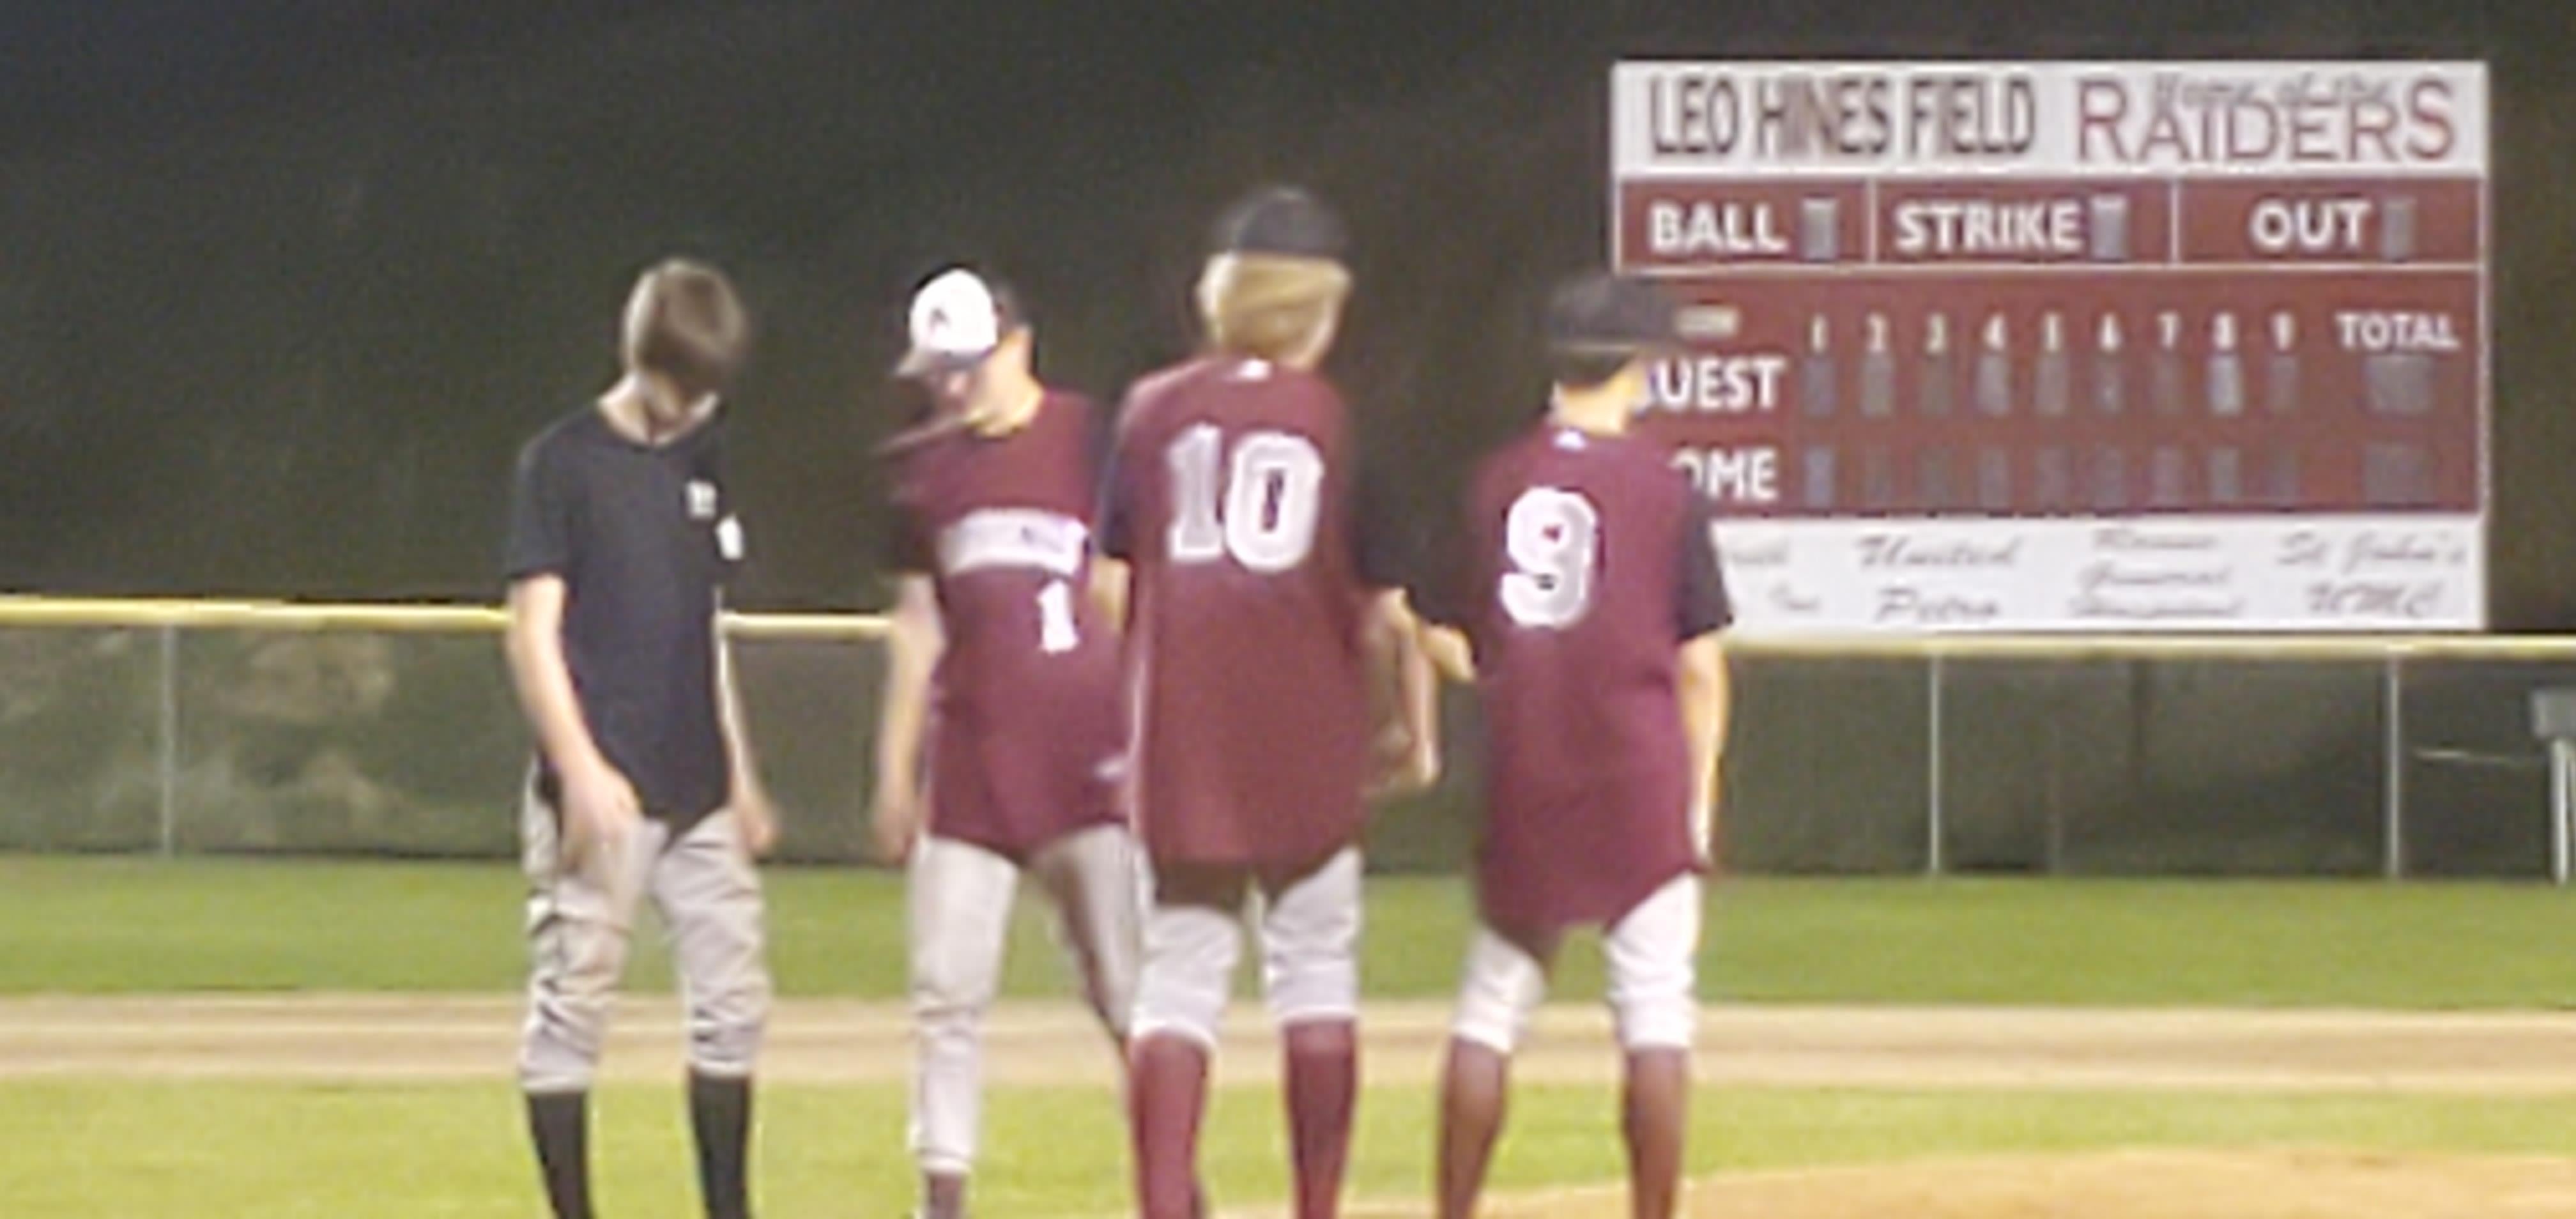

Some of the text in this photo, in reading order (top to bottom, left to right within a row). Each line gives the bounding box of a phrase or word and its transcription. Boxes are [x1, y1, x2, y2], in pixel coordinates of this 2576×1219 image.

[1652, 74, 2037, 157] LEO HINES FIELD
[2076, 77, 2457, 162] RAIDERS
[1650, 199, 1786, 250] BALL
[1895, 201, 2083, 251] STRIKE
[2250, 201, 2370, 249] OUT
[1811, 314, 1827, 353] 1
[1983, 312, 2007, 353] 4
[2335, 312, 2460, 351] TOTAL
[1653, 355, 1786, 414] UEST
[1165, 422, 1325, 574] 10
[1667, 447, 1779, 503] OME
[1499, 486, 1598, 629] 9
[1036, 578, 1080, 656] 1
